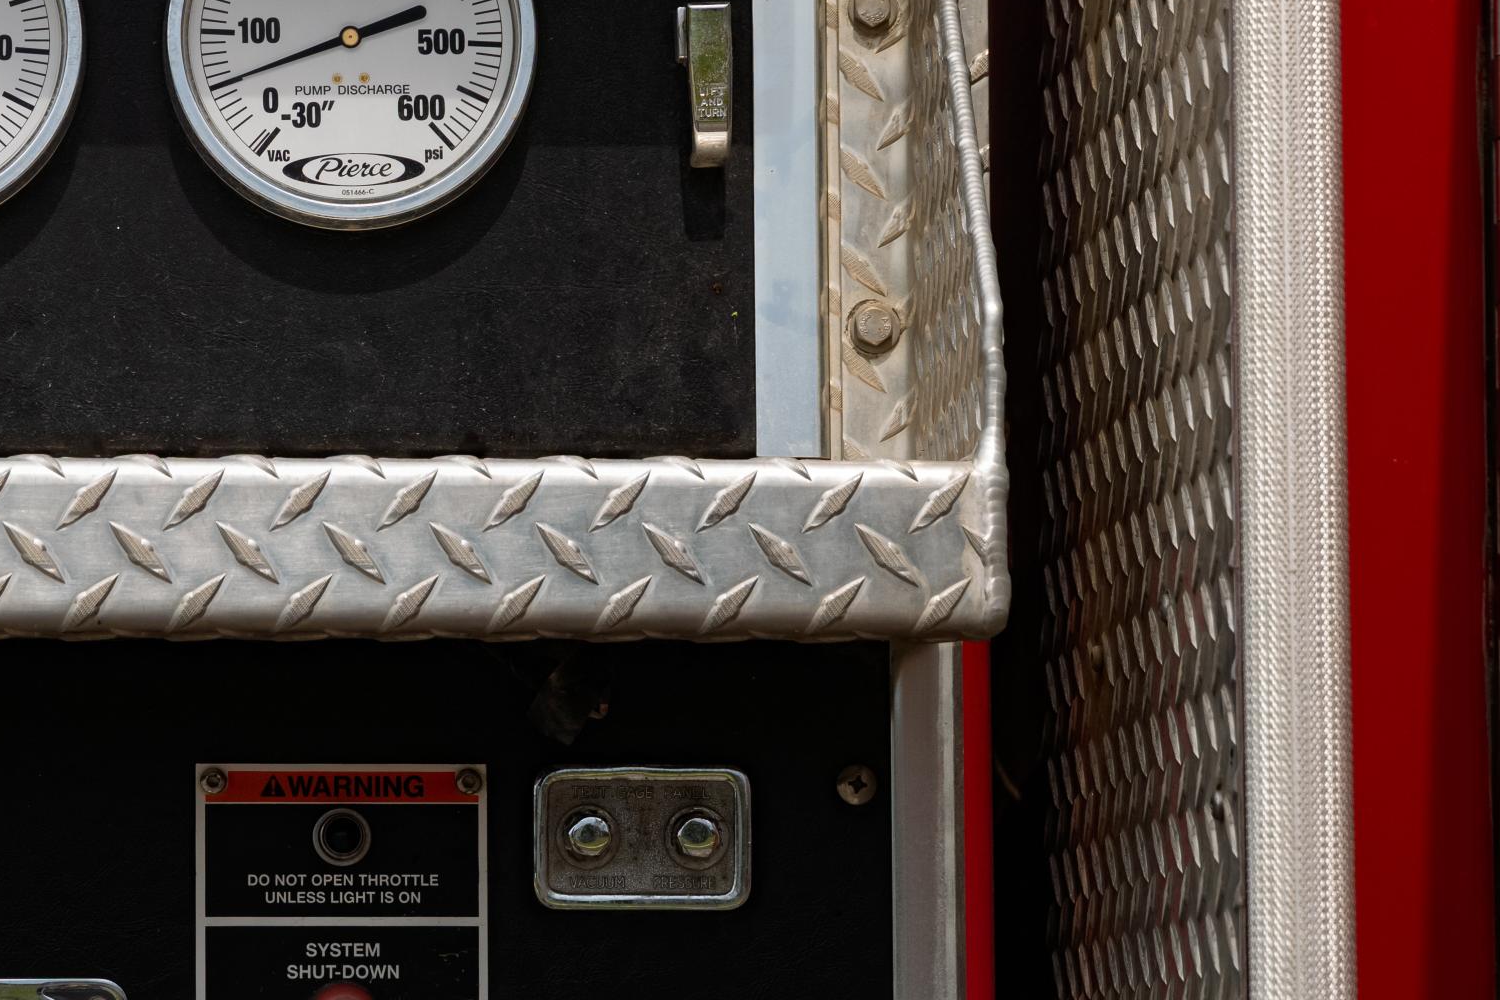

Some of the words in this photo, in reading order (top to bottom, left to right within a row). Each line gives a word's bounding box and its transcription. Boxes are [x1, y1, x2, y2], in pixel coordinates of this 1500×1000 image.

[238, 17, 281, 44] 100
[418, 28, 465, 55] 500
[295, 86, 331, 96] PUMP
[338, 84, 410, 95] DISCHARGE
[699, 87, 725, 97] LIFT
[263, 87, 278, 113] 0
[398, 94, 445, 121] 600
[700, 98, 723, 107] AND
[698, 108, 726, 118] TURN
[268, 150, 290, 162] VAC
[425, 146, 444, 163] psi
[315, 158, 392, 180] Pierce
[287, 775, 424, 797] WARNING
[248, 874, 270, 887] DO
[275, 874, 308, 887] NOT
[312, 874, 354, 887] OPEN
[359, 874, 439, 887] THROTTLE
[265, 891, 326, 904] UNLESS
[330, 891, 376, 904] LIGHT
[380, 891, 394, 904] IS
[398, 891, 421, 904] ON
[306, 942, 381, 958] SYSTEM
[286, 964, 400, 980] SHUT-DOWN
